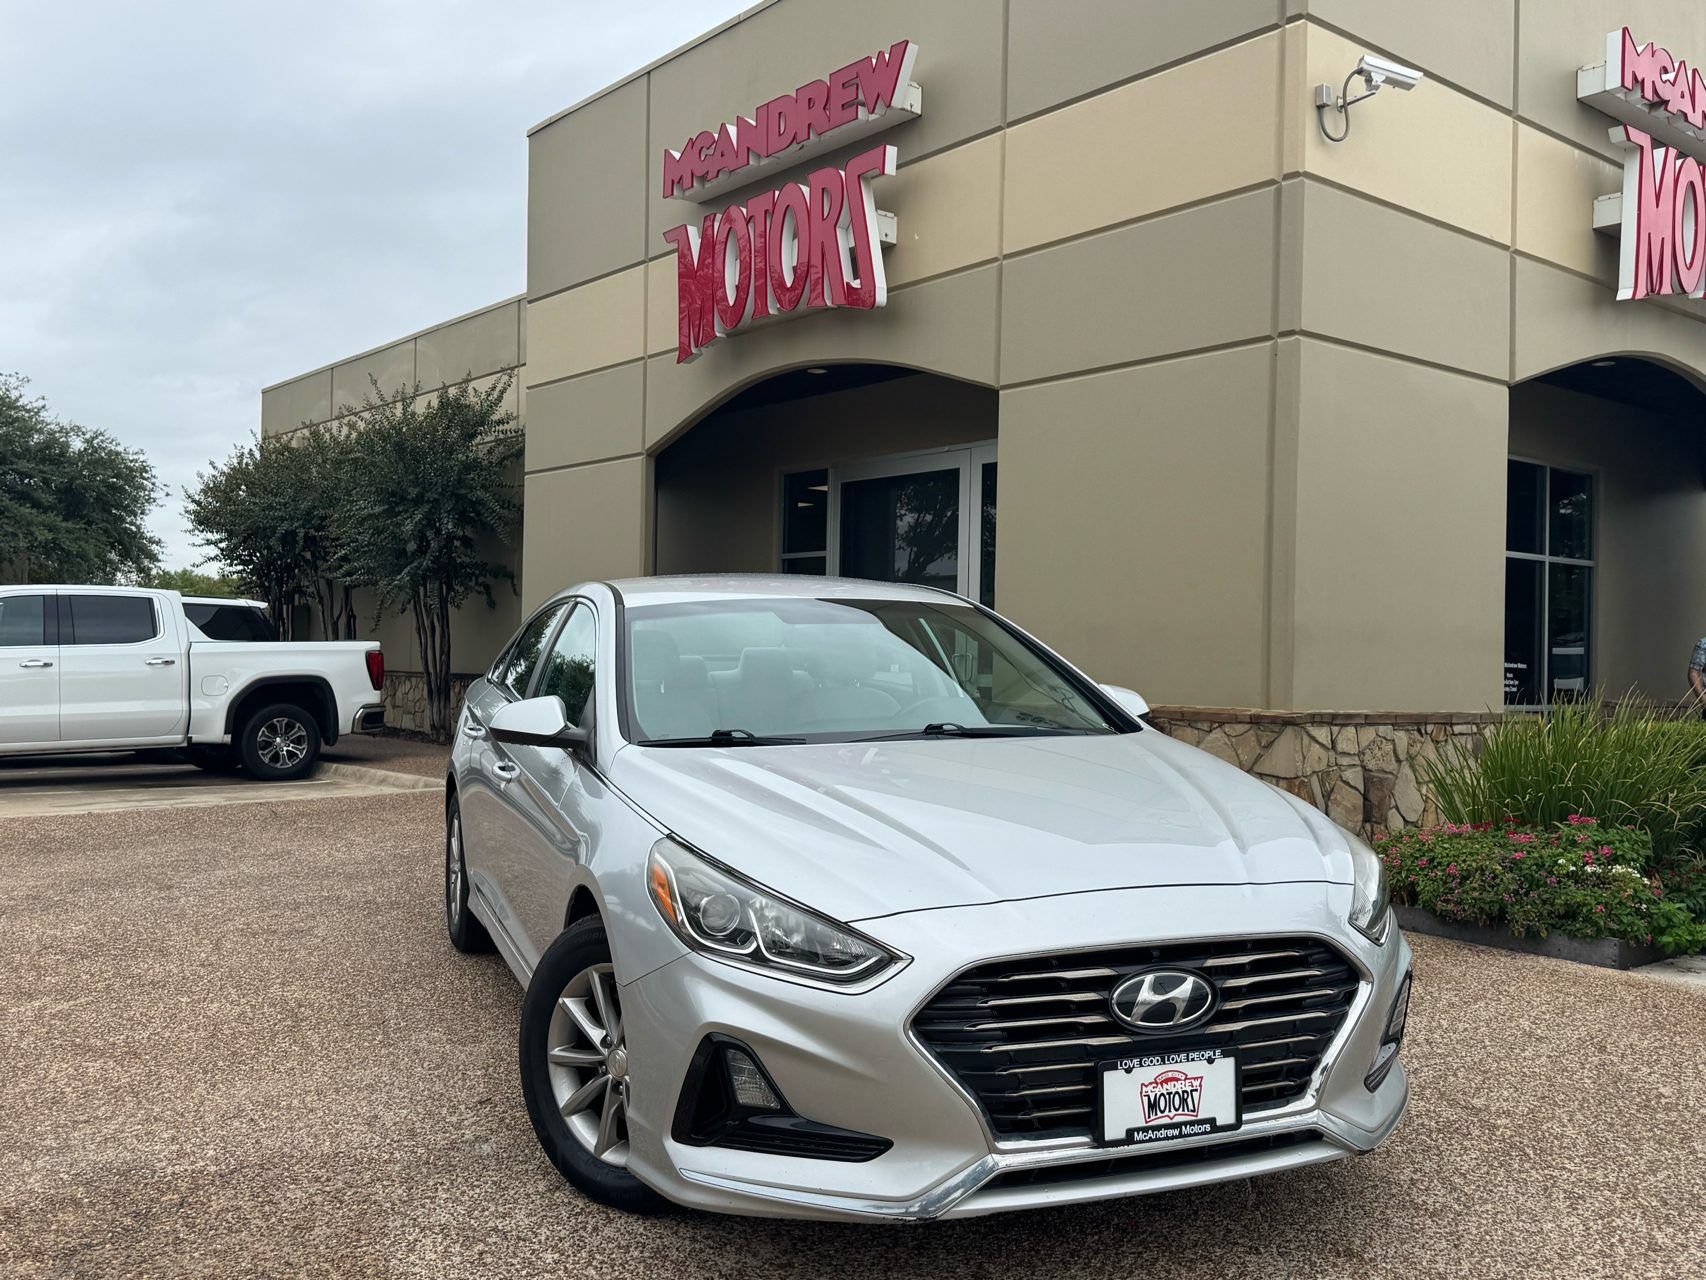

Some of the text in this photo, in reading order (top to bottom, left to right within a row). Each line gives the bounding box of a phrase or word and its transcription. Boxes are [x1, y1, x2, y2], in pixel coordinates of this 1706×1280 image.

[663, 144, 889, 364] MOTORS
[1117, 1049, 1223, 1069] LOVE GOD. LOVE PEOPLE.
[1143, 1088, 1198, 1119] MOTORS
[1134, 1123, 1211, 1141] McAndrew Motors
